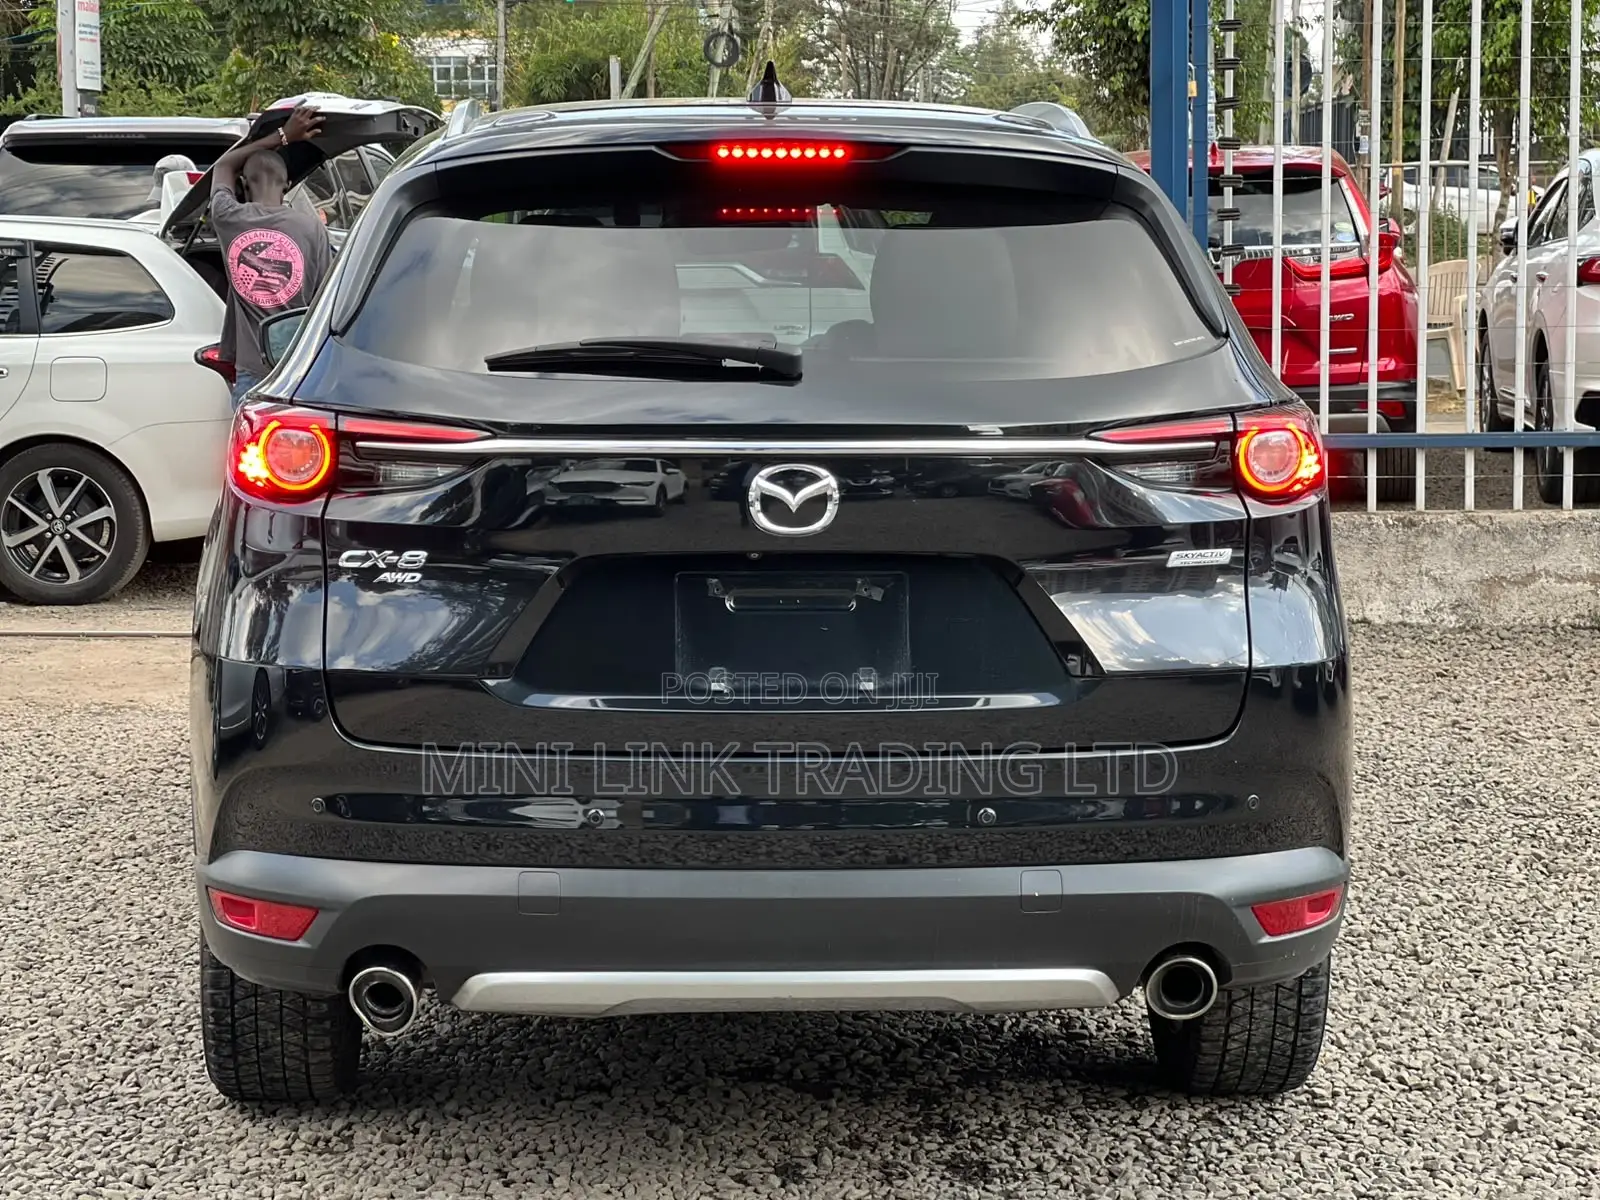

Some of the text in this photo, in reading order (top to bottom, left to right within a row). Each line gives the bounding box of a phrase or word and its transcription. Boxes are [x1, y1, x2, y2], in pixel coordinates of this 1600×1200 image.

[240, 232, 297, 252] ATLANTIC CITY
[285, 268, 302, 296] SERVICE
[338, 549, 428, 569] CX-8
[1176, 551, 1226, 559] SKYACTIV
[372, 572, 422, 583] AWD
